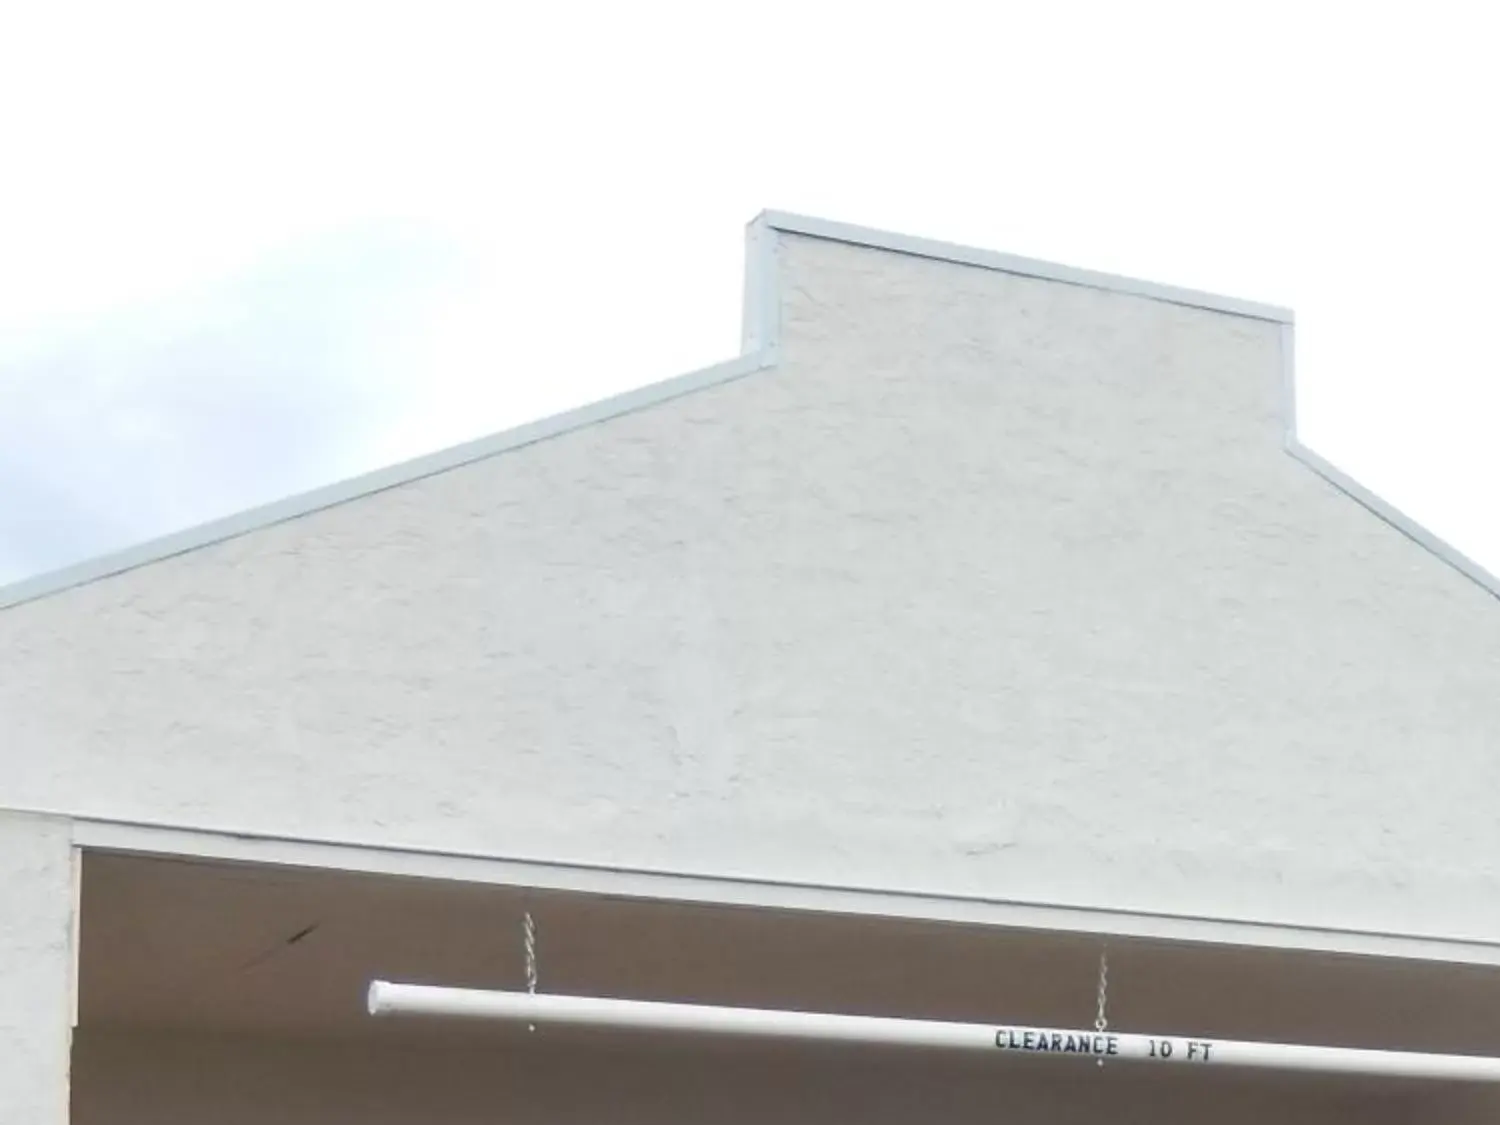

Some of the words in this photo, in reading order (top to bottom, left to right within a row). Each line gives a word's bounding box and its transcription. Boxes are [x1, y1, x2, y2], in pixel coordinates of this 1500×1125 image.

[995, 1030, 1119, 1056] CLEARANCE
[1149, 1040, 1173, 1059] 10
[1187, 1043, 1213, 1061] FT
